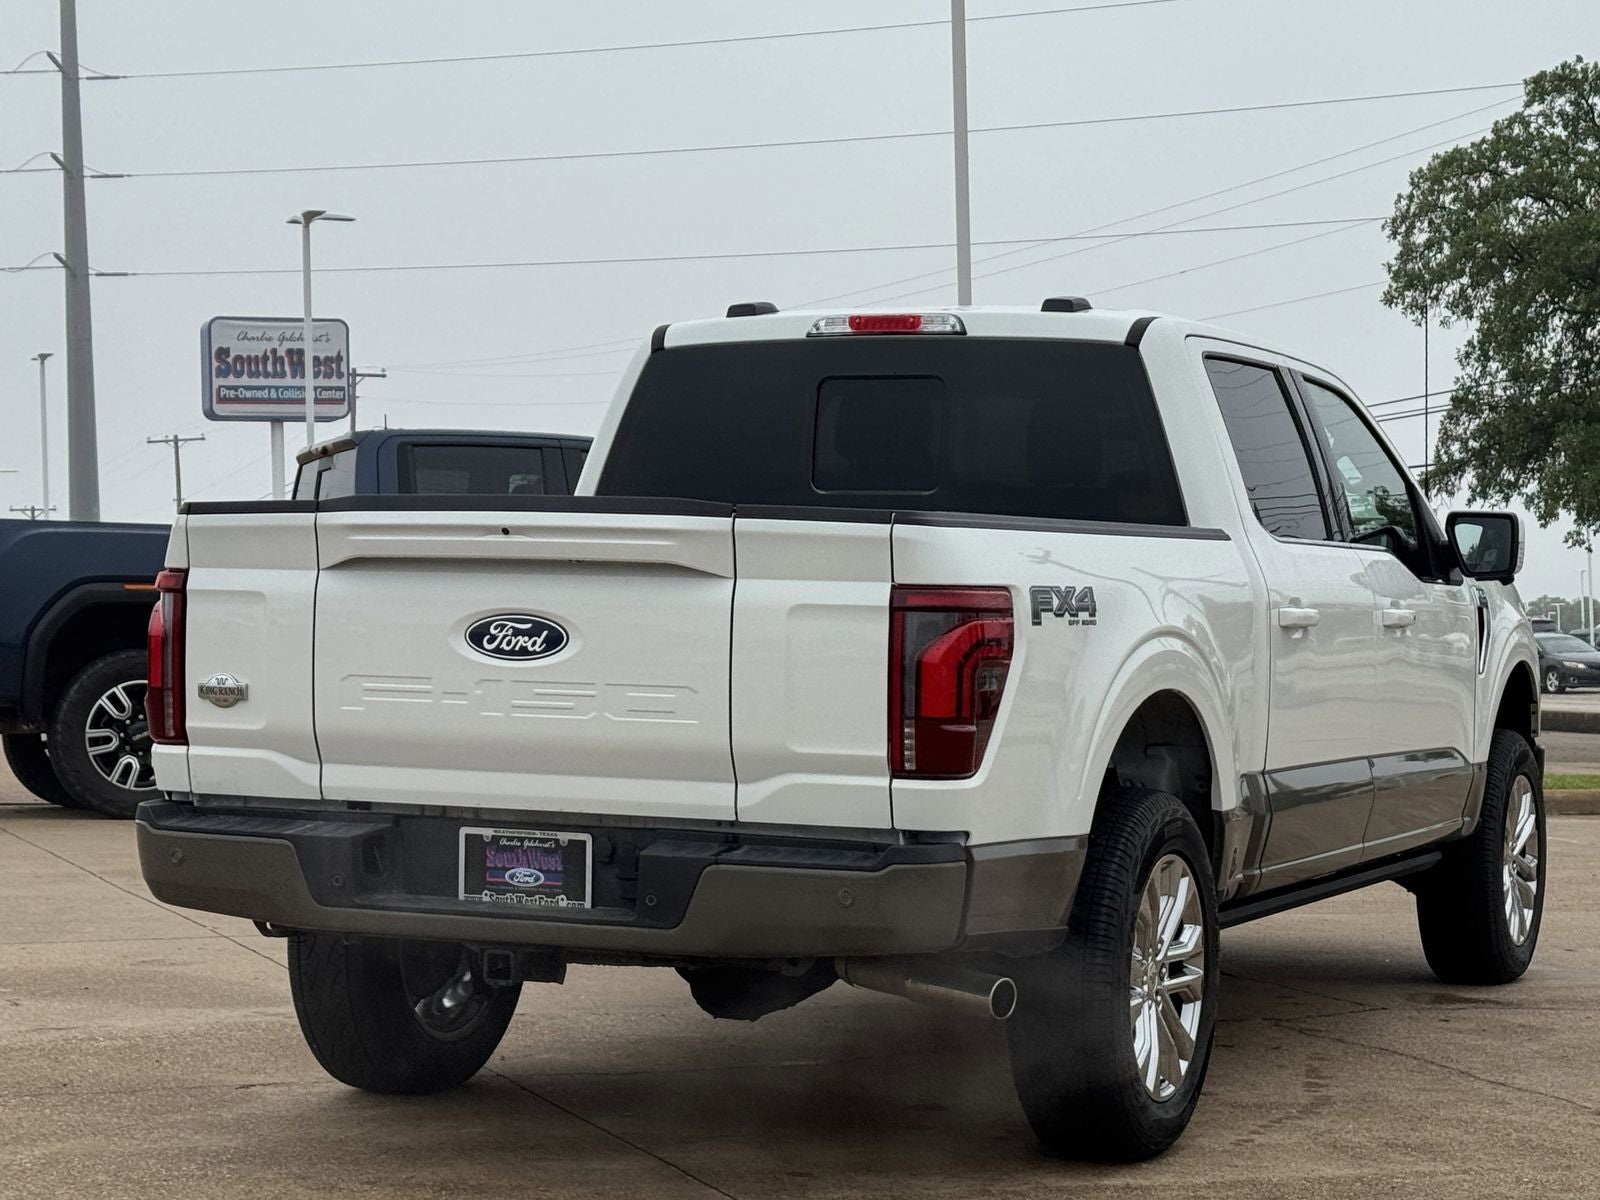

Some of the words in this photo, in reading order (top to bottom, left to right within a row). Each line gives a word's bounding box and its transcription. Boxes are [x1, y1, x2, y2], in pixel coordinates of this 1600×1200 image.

[236, 330, 274, 341] Charlie
[277, 331, 331, 347] Gilchist's
[214, 346, 345, 380] SouthWest
[220, 387, 268, 399] Pre-Owned
[269, 389, 277, 398] &
[279, 387, 315, 400] Collisi
[316, 387, 345, 400] Center
[1029, 586, 1097, 626] FX4
[482, 620, 548, 652] Ford
[200, 684, 218, 696] KING
[513, 870, 536, 883] Ford
